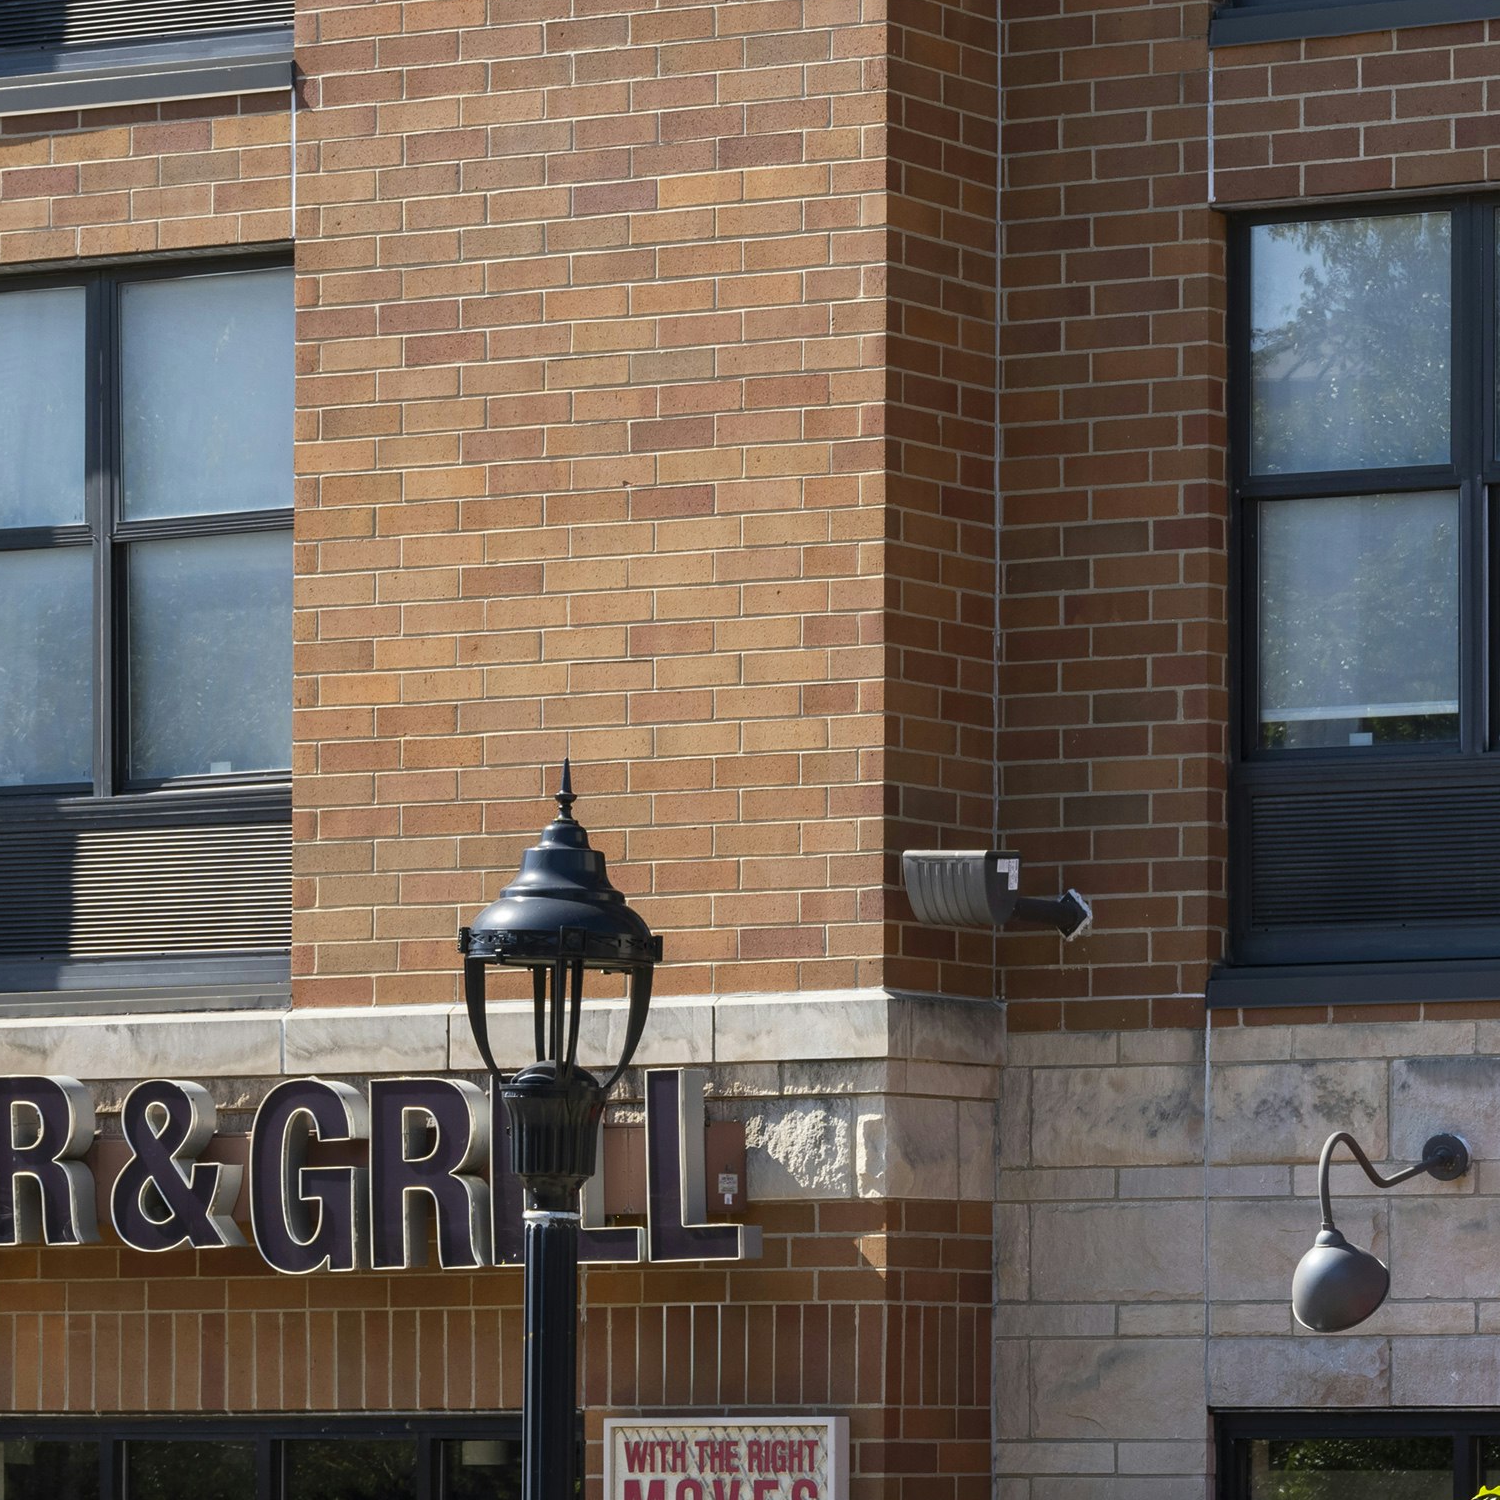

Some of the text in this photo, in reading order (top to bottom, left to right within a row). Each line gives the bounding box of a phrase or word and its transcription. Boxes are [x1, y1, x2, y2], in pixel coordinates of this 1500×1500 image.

[624, 1439, 819, 1473] WITH THE RIGHT
